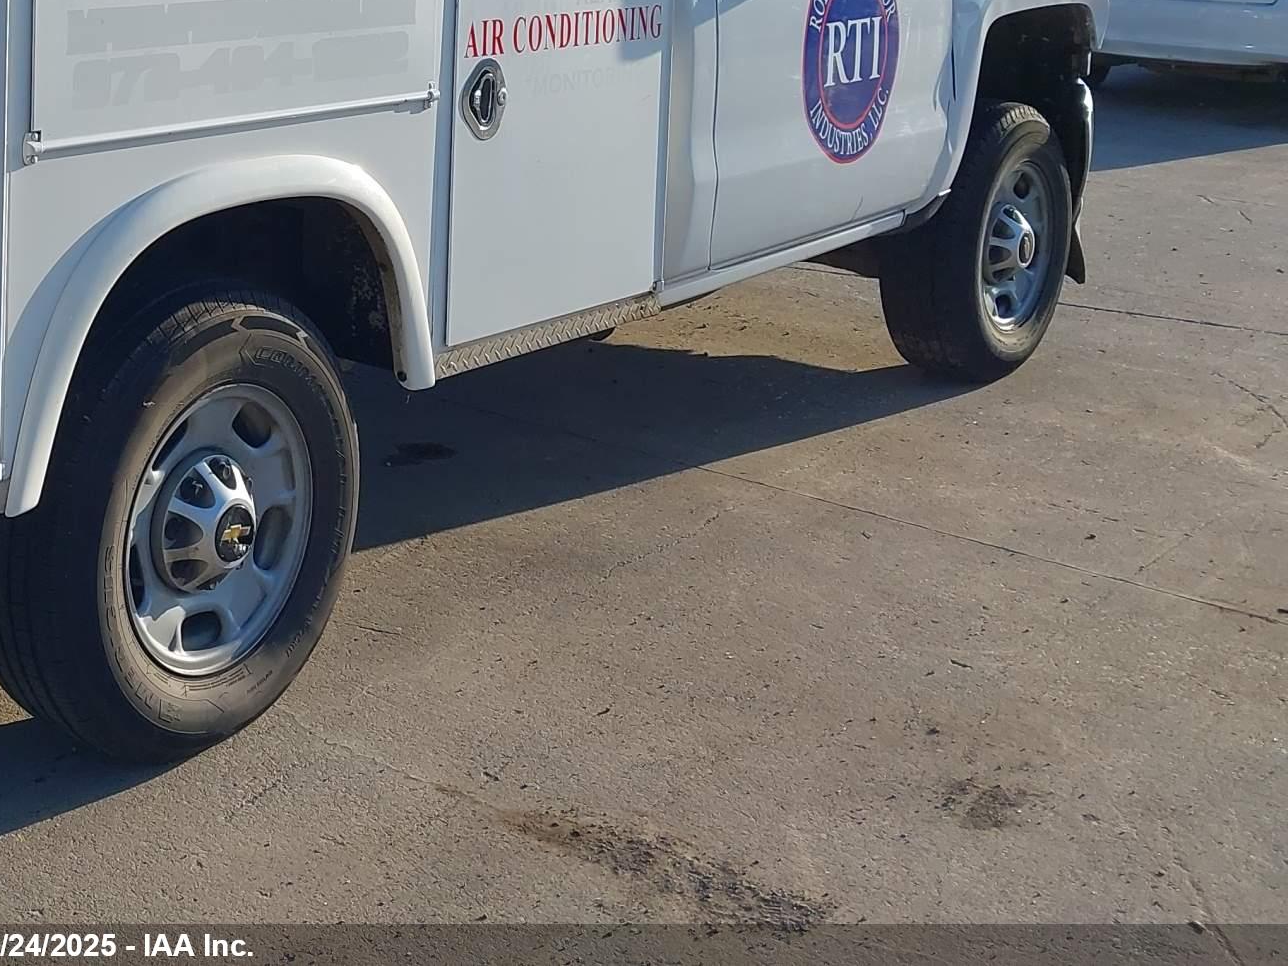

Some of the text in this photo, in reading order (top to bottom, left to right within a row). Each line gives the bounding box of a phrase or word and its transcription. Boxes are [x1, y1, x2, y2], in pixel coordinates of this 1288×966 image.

[464, 19, 505, 59] AIR
[513, 4, 663, 54] CONDITIONING
[824, 16, 883, 88] RTI
